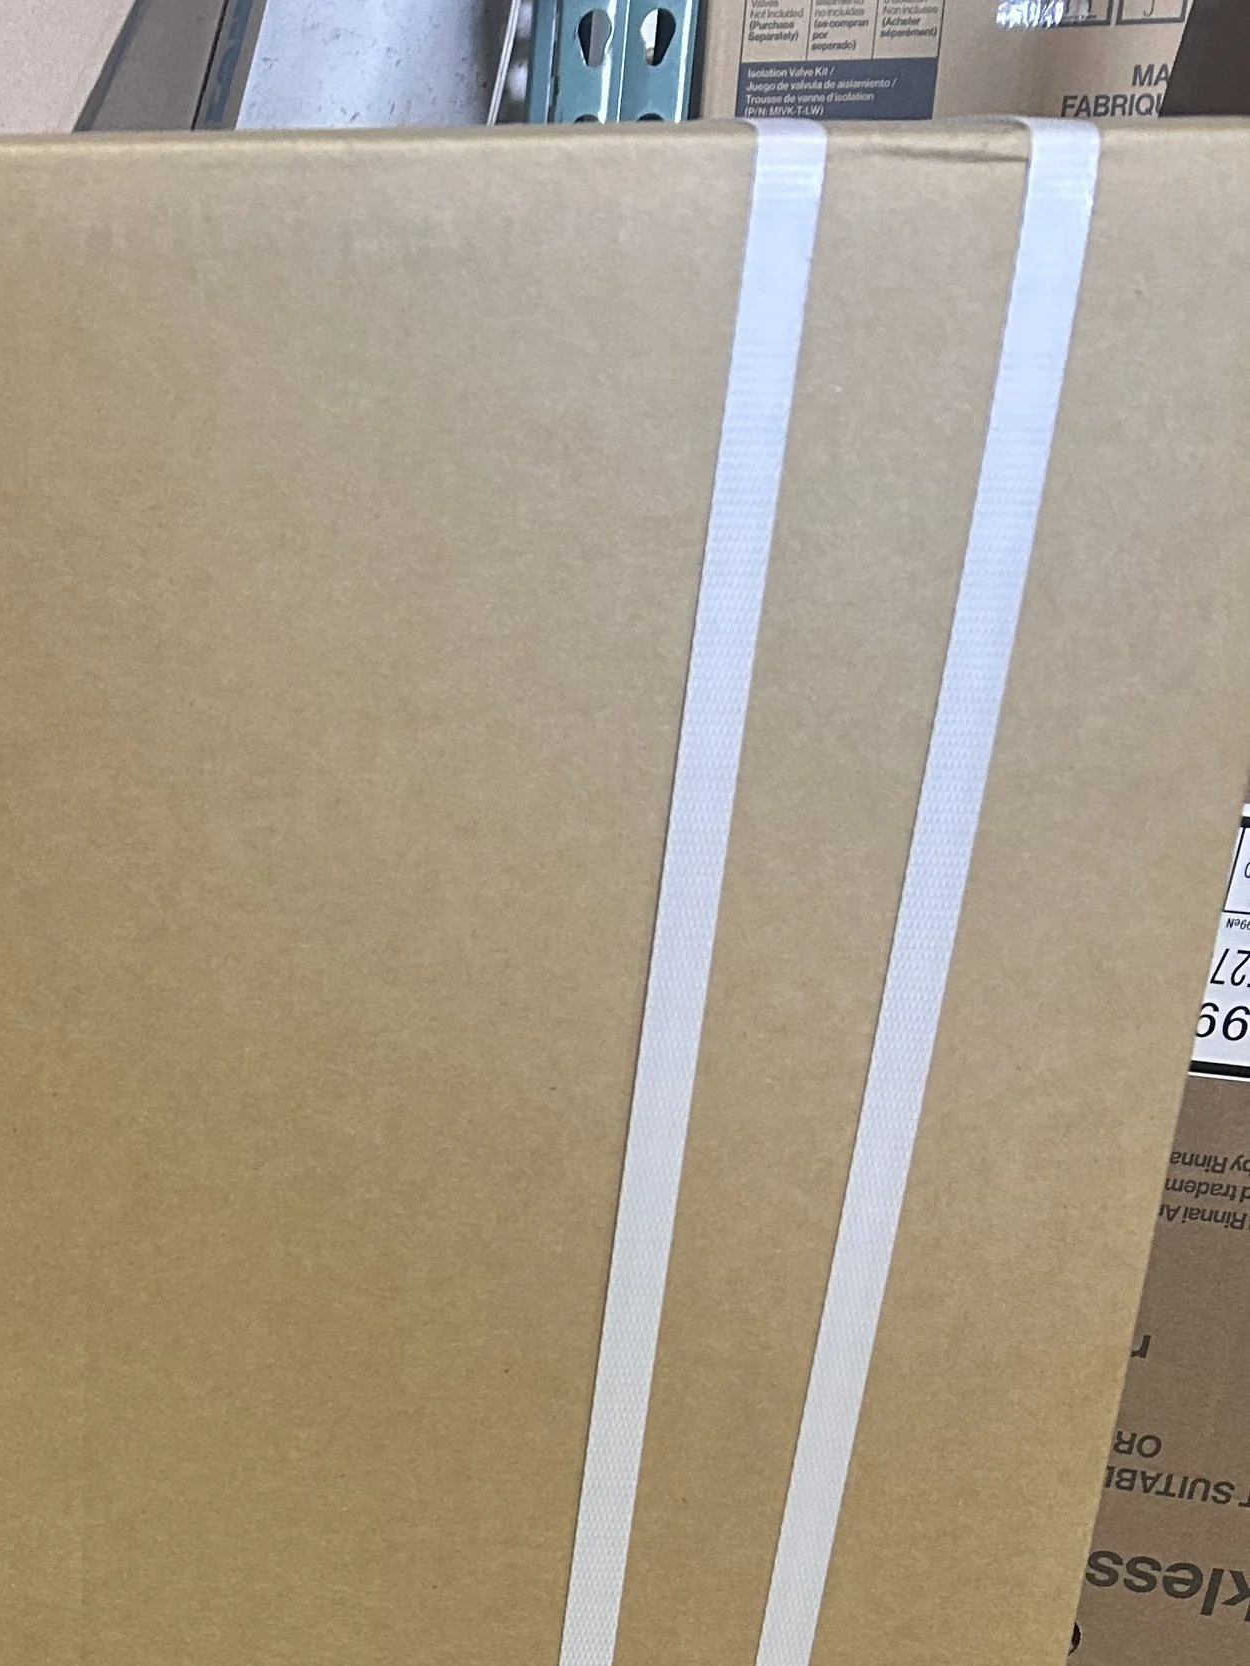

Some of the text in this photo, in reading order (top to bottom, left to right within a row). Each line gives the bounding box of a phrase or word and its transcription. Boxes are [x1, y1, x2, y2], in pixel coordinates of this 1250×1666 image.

[749, 20, 795, 31] (Purchase
[748, 30, 799, 42] Separately)
[747, 68, 788, 78] Isolation
[788, 67, 814, 77] Valve
[814, 66, 828, 76] Kit
[746, 81, 776, 92] Juego
[776, 81, 790, 91] de
[823, 79, 836, 90] de
[836, 78, 891, 89] aislamiento
[745, 94, 783, 104] Trousse
[783, 94, 796, 103] de
[1182, 1207, 1248, 1230] Rinnai
